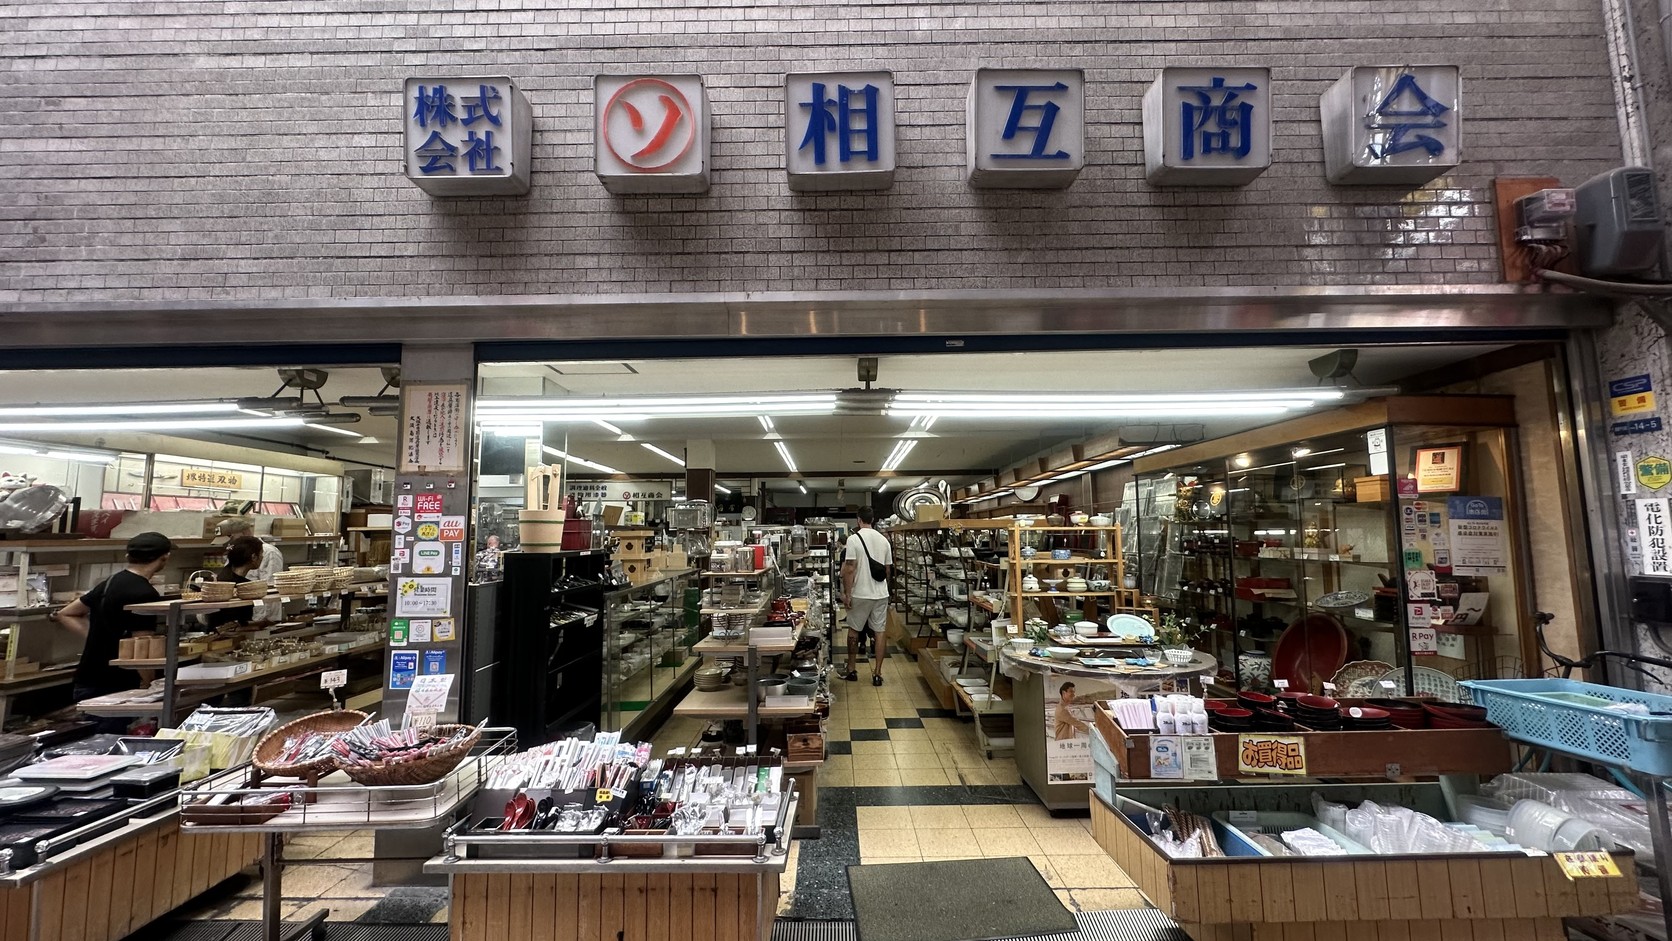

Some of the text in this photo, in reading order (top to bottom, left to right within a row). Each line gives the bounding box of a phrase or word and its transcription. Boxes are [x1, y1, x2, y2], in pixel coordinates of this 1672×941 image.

[413, 84, 502, 128] 株式
[414, 129, 502, 174] 会社
[417, 501, 441, 510] FREE
[443, 520, 461, 528] au
[443, 529, 460, 537] PAY
[1418, 632, 1434, 641] Pay
[1242, 738, 1303, 770] お買得品
